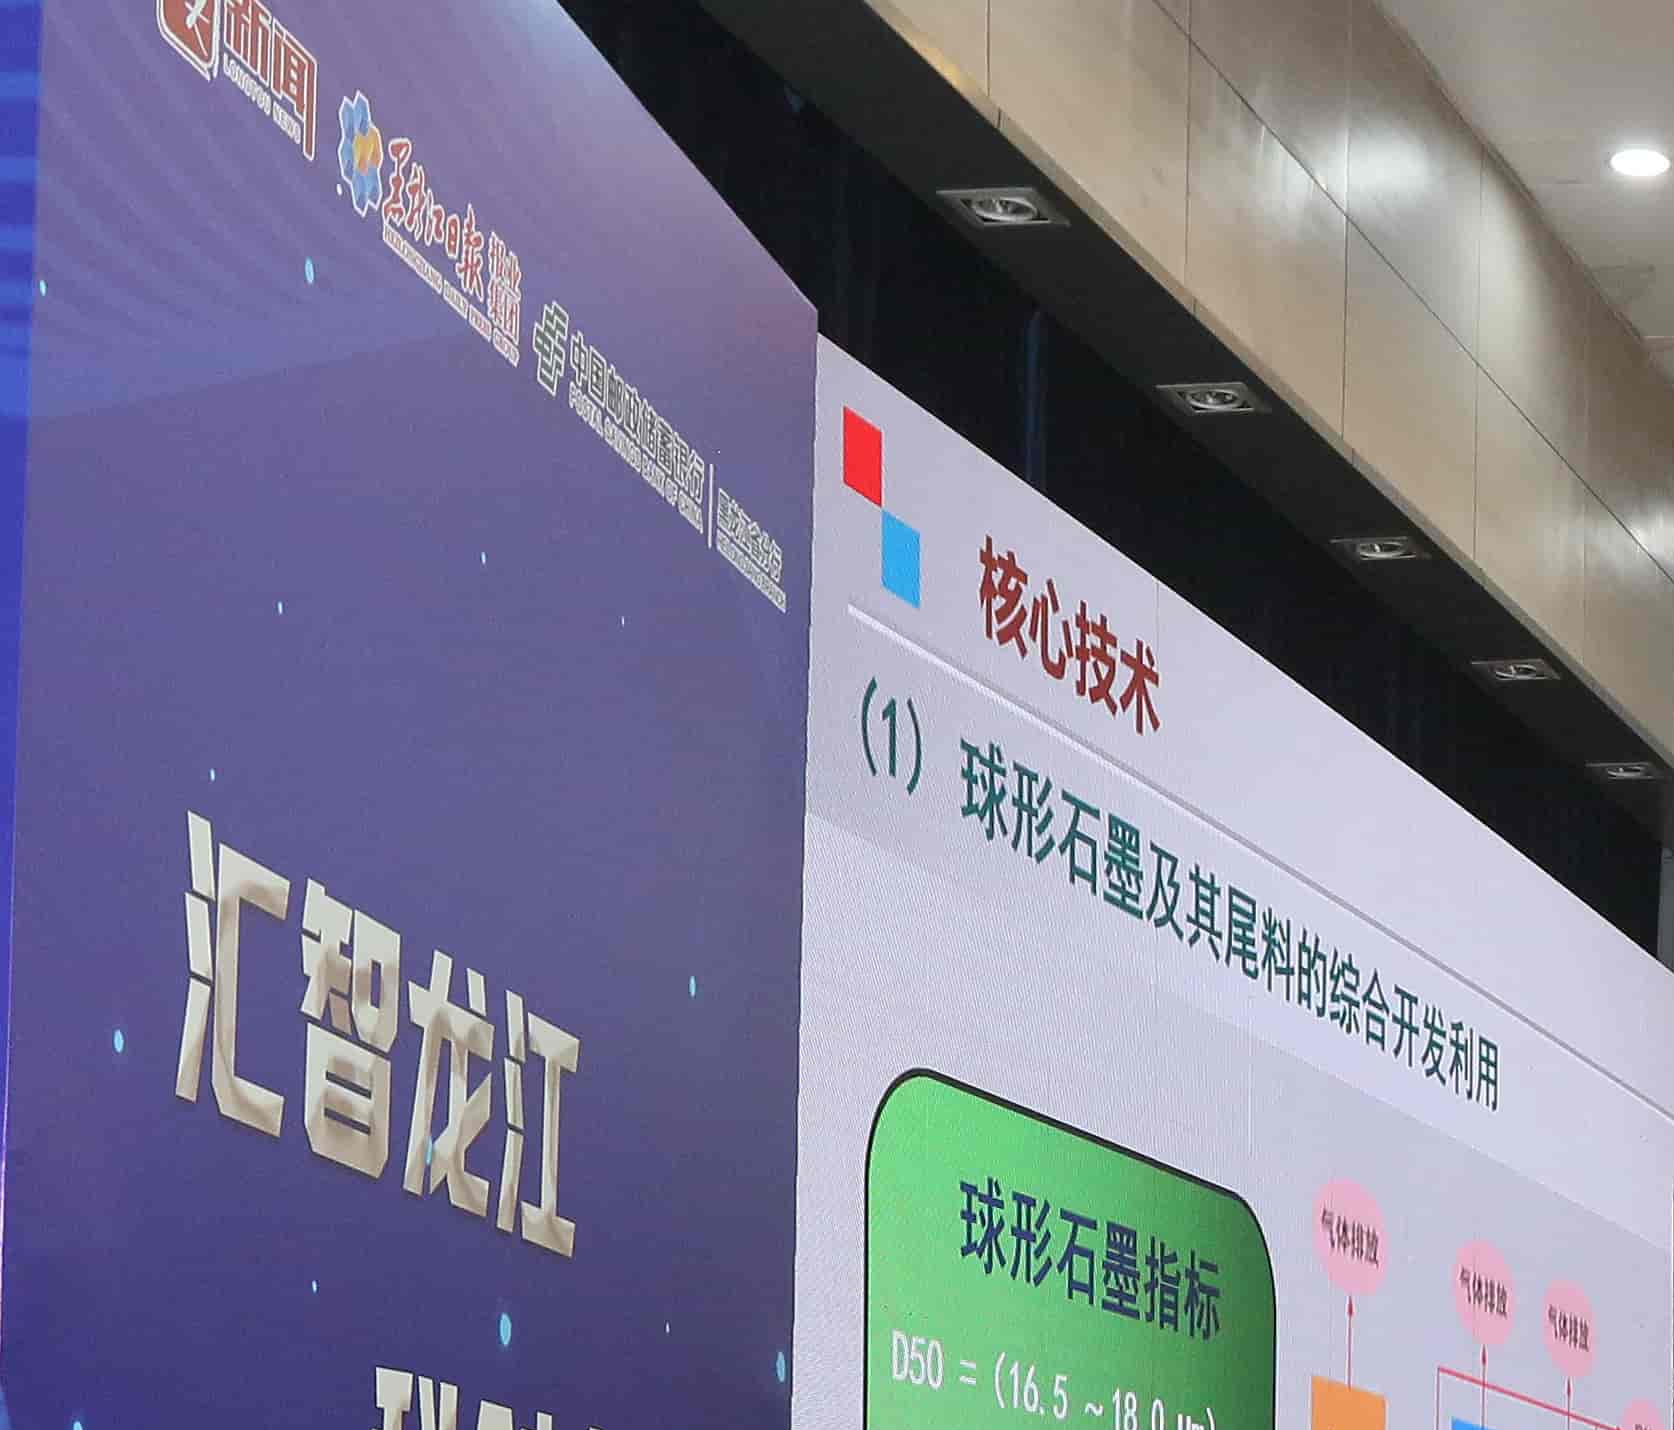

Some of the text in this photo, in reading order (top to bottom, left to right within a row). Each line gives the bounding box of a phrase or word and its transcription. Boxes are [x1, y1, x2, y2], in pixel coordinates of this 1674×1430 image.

[569, 331, 705, 505] 中国邮政储蓄银行
[979, 535, 1161, 735] 核心技术
[959, 737, 1500, 1112] 球形石墨及其尾料的综合开发利用
[175, 810, 581, 1259] 汇智龙江
[959, 1177, 1223, 1342] 球形石墨指标
[1321, 1206, 1379, 1269] 气体排放
[1458, 1266, 1509, 1320] 气体排放
[891, 1328, 945, 1391] D50
